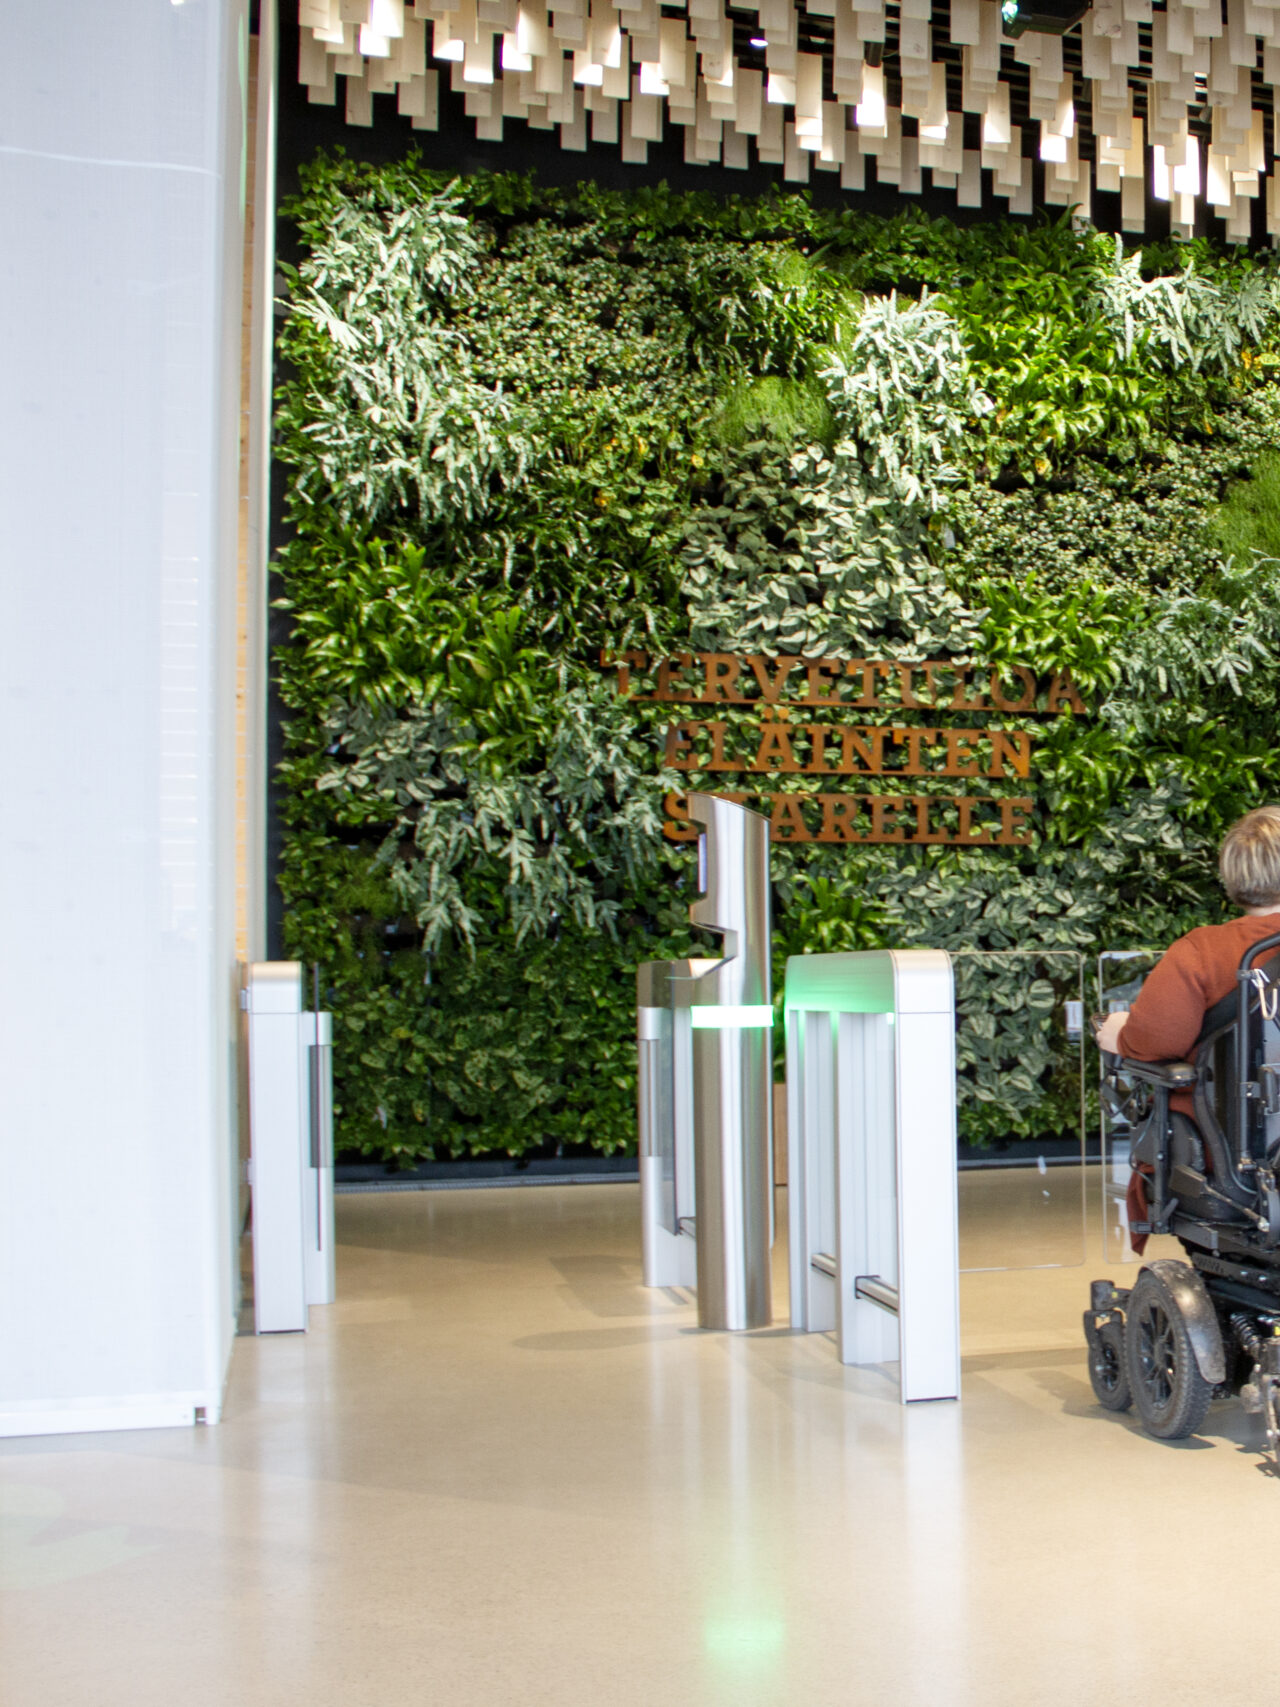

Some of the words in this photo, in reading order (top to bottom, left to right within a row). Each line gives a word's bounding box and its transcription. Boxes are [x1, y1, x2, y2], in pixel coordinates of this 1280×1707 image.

[600, 650, 1087, 713] TERVETULOA
[664, 707, 1034, 778] ELÄINTEN
[662, 791, 1033, 845] SARELLE
